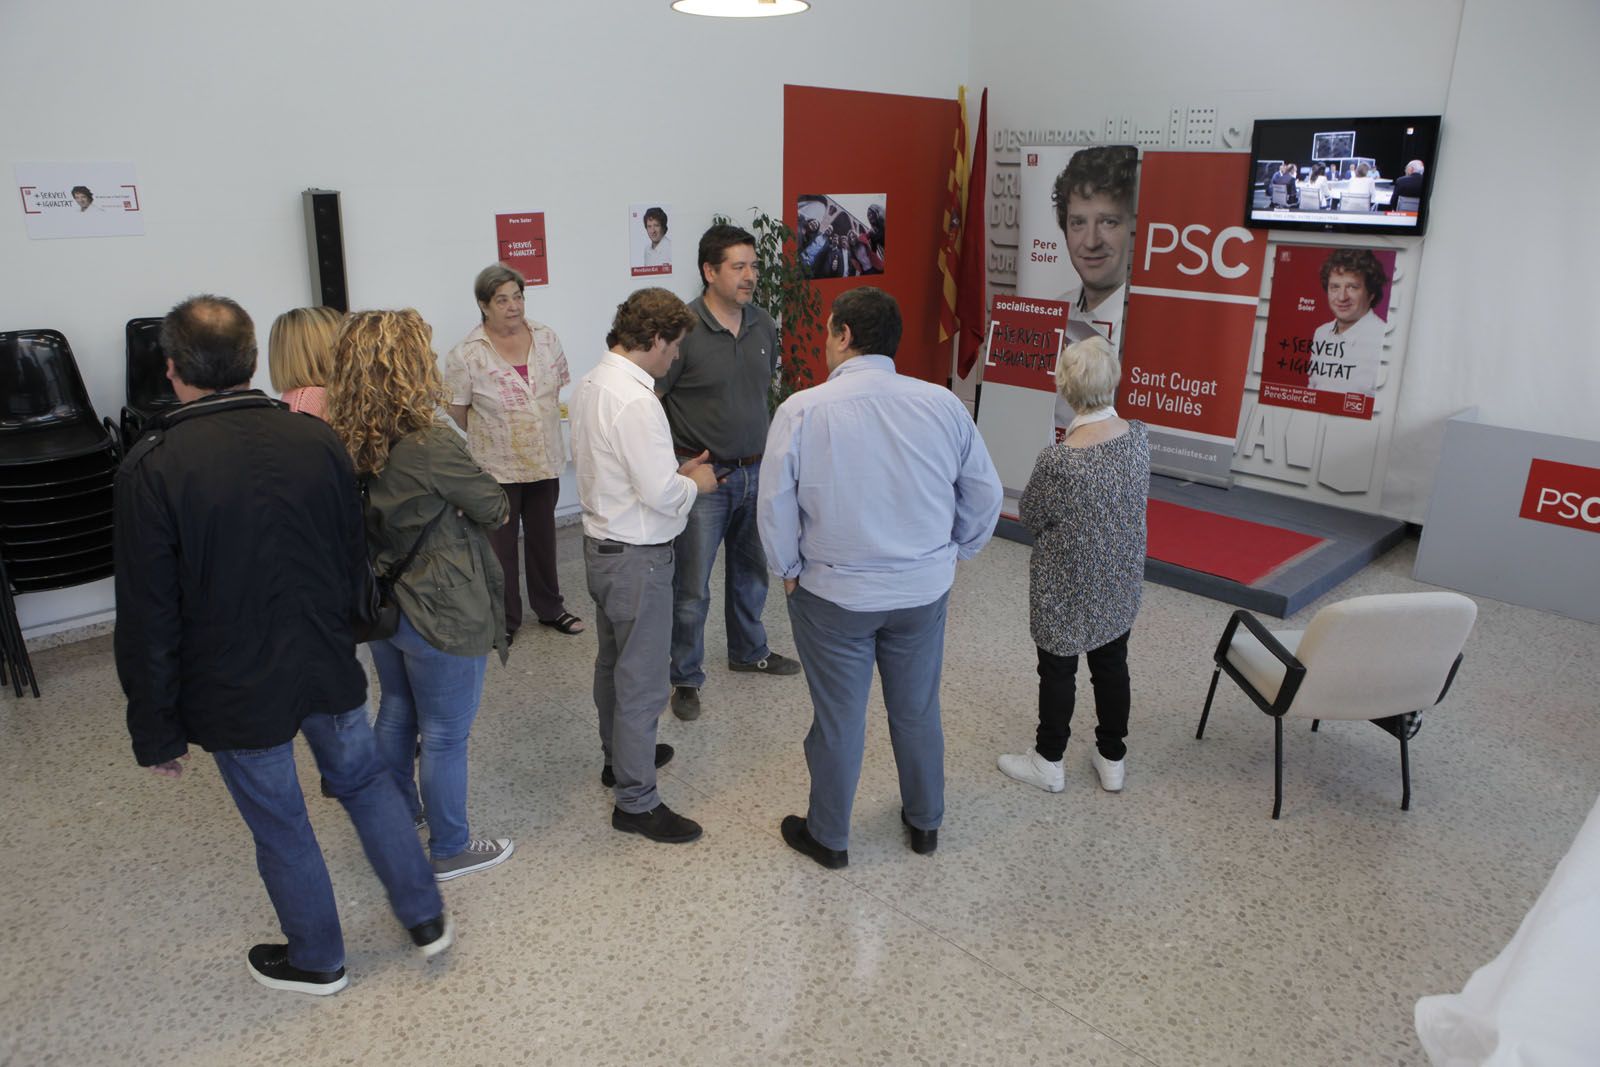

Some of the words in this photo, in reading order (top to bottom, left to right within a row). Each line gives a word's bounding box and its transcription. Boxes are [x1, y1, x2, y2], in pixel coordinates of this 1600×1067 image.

[1033, 239, 1057, 250] Pere
[1144, 223, 1254, 279] PSC
[1031, 251, 1057, 264] Soler
[996, 300, 1063, 317] socialistes.cat
[1297, 304, 1316, 312] Soler
[1300, 297, 1315, 305] Pere
[1130, 367, 1167, 389] Sant
[1170, 372, 1218, 399] Cugat
[1128, 390, 1150, 409] del
[1155, 392, 1202, 416] Vallès
[1345, 401, 1362, 411] PSC
[1148, 444, 1218, 463] gat.socialistes.cat
[1536, 487, 1600, 524] PSC
